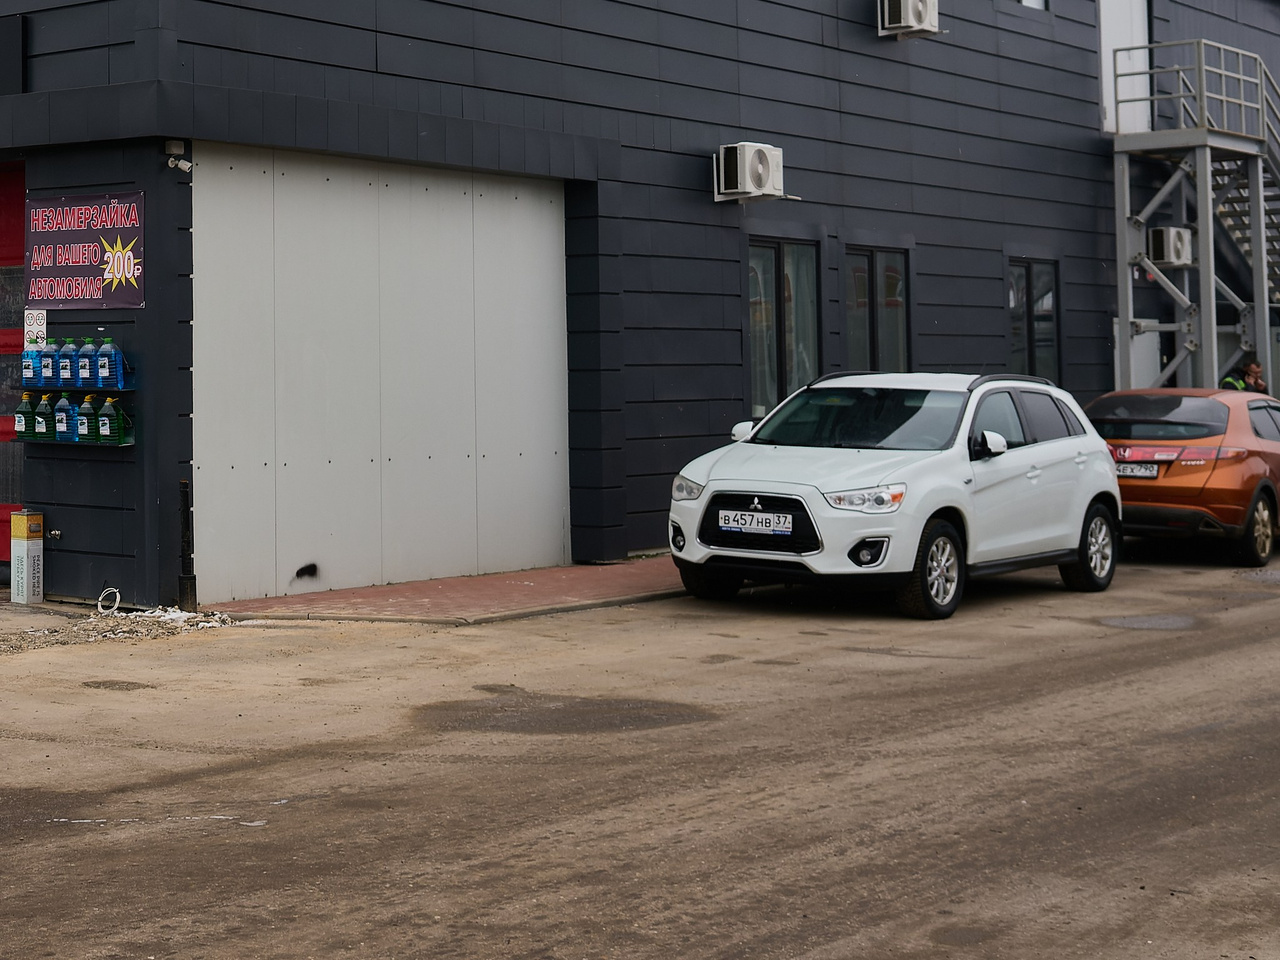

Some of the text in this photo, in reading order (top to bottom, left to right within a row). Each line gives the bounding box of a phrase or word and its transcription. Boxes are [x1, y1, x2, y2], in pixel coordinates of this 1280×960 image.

[31, 199, 139, 232] НЕЗАМЕРЗАЙКА
[31, 242, 101, 271] ДЛЯ ВАШЕГО
[28, 276, 103, 300] АВТОМОБИЛЯ
